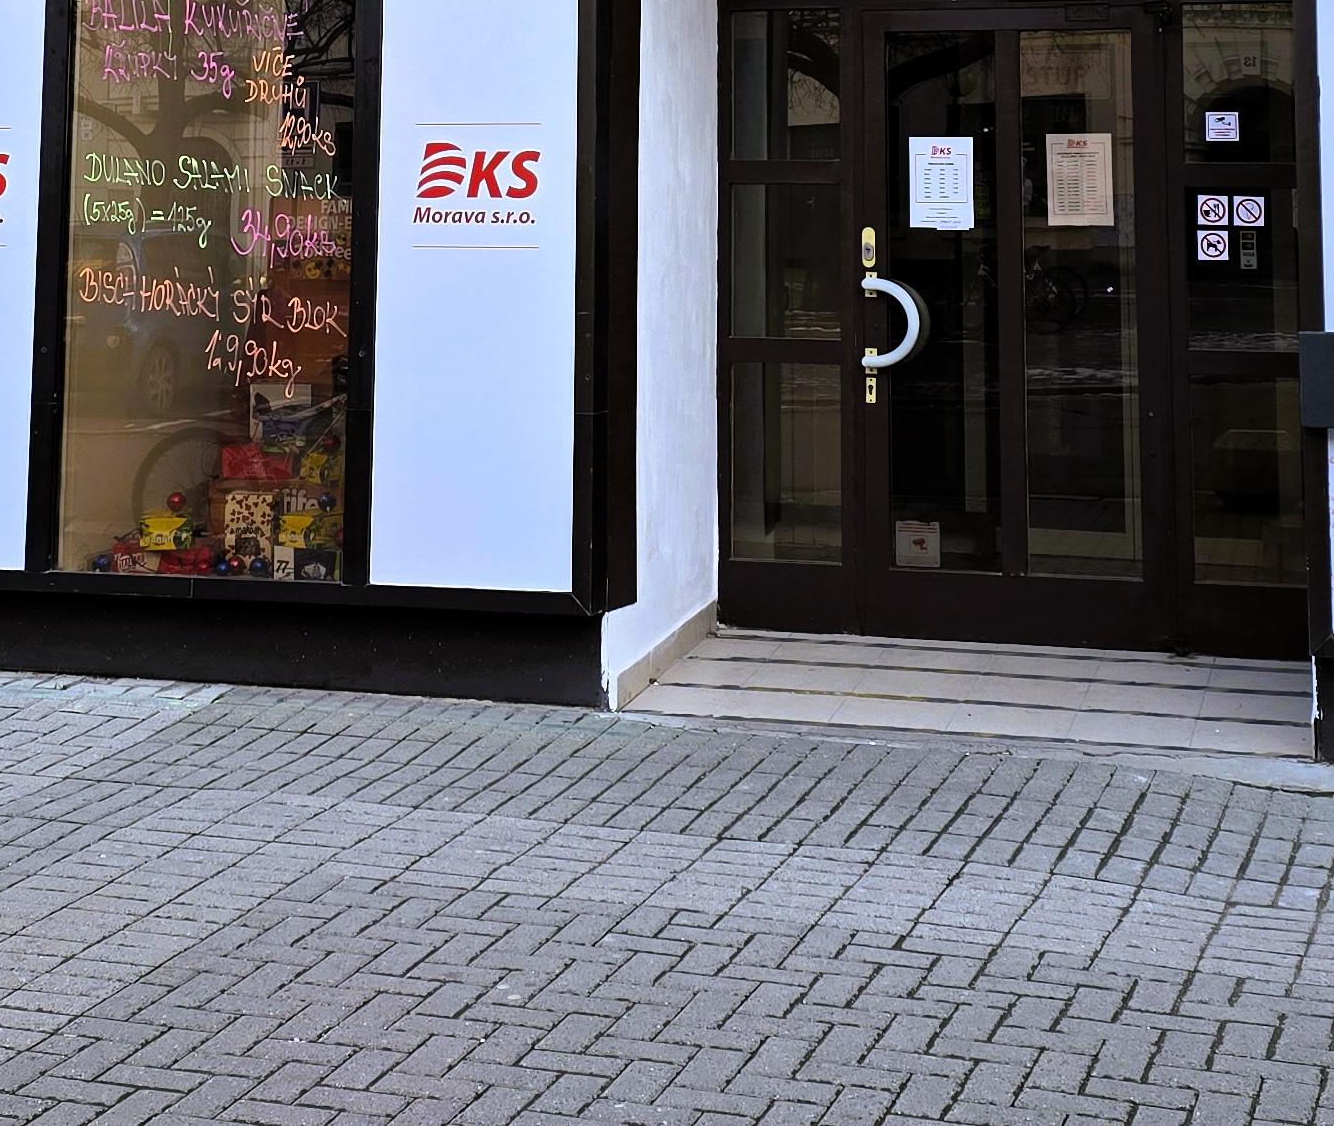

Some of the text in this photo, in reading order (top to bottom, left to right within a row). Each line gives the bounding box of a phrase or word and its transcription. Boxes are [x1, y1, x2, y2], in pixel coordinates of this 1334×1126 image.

[84, 152, 166, 187] DULANO
[172, 155, 250, 194] SALAMI
[413, 206, 537, 226] Morava s.r.o.
[286, 297, 348, 338] BLOK
